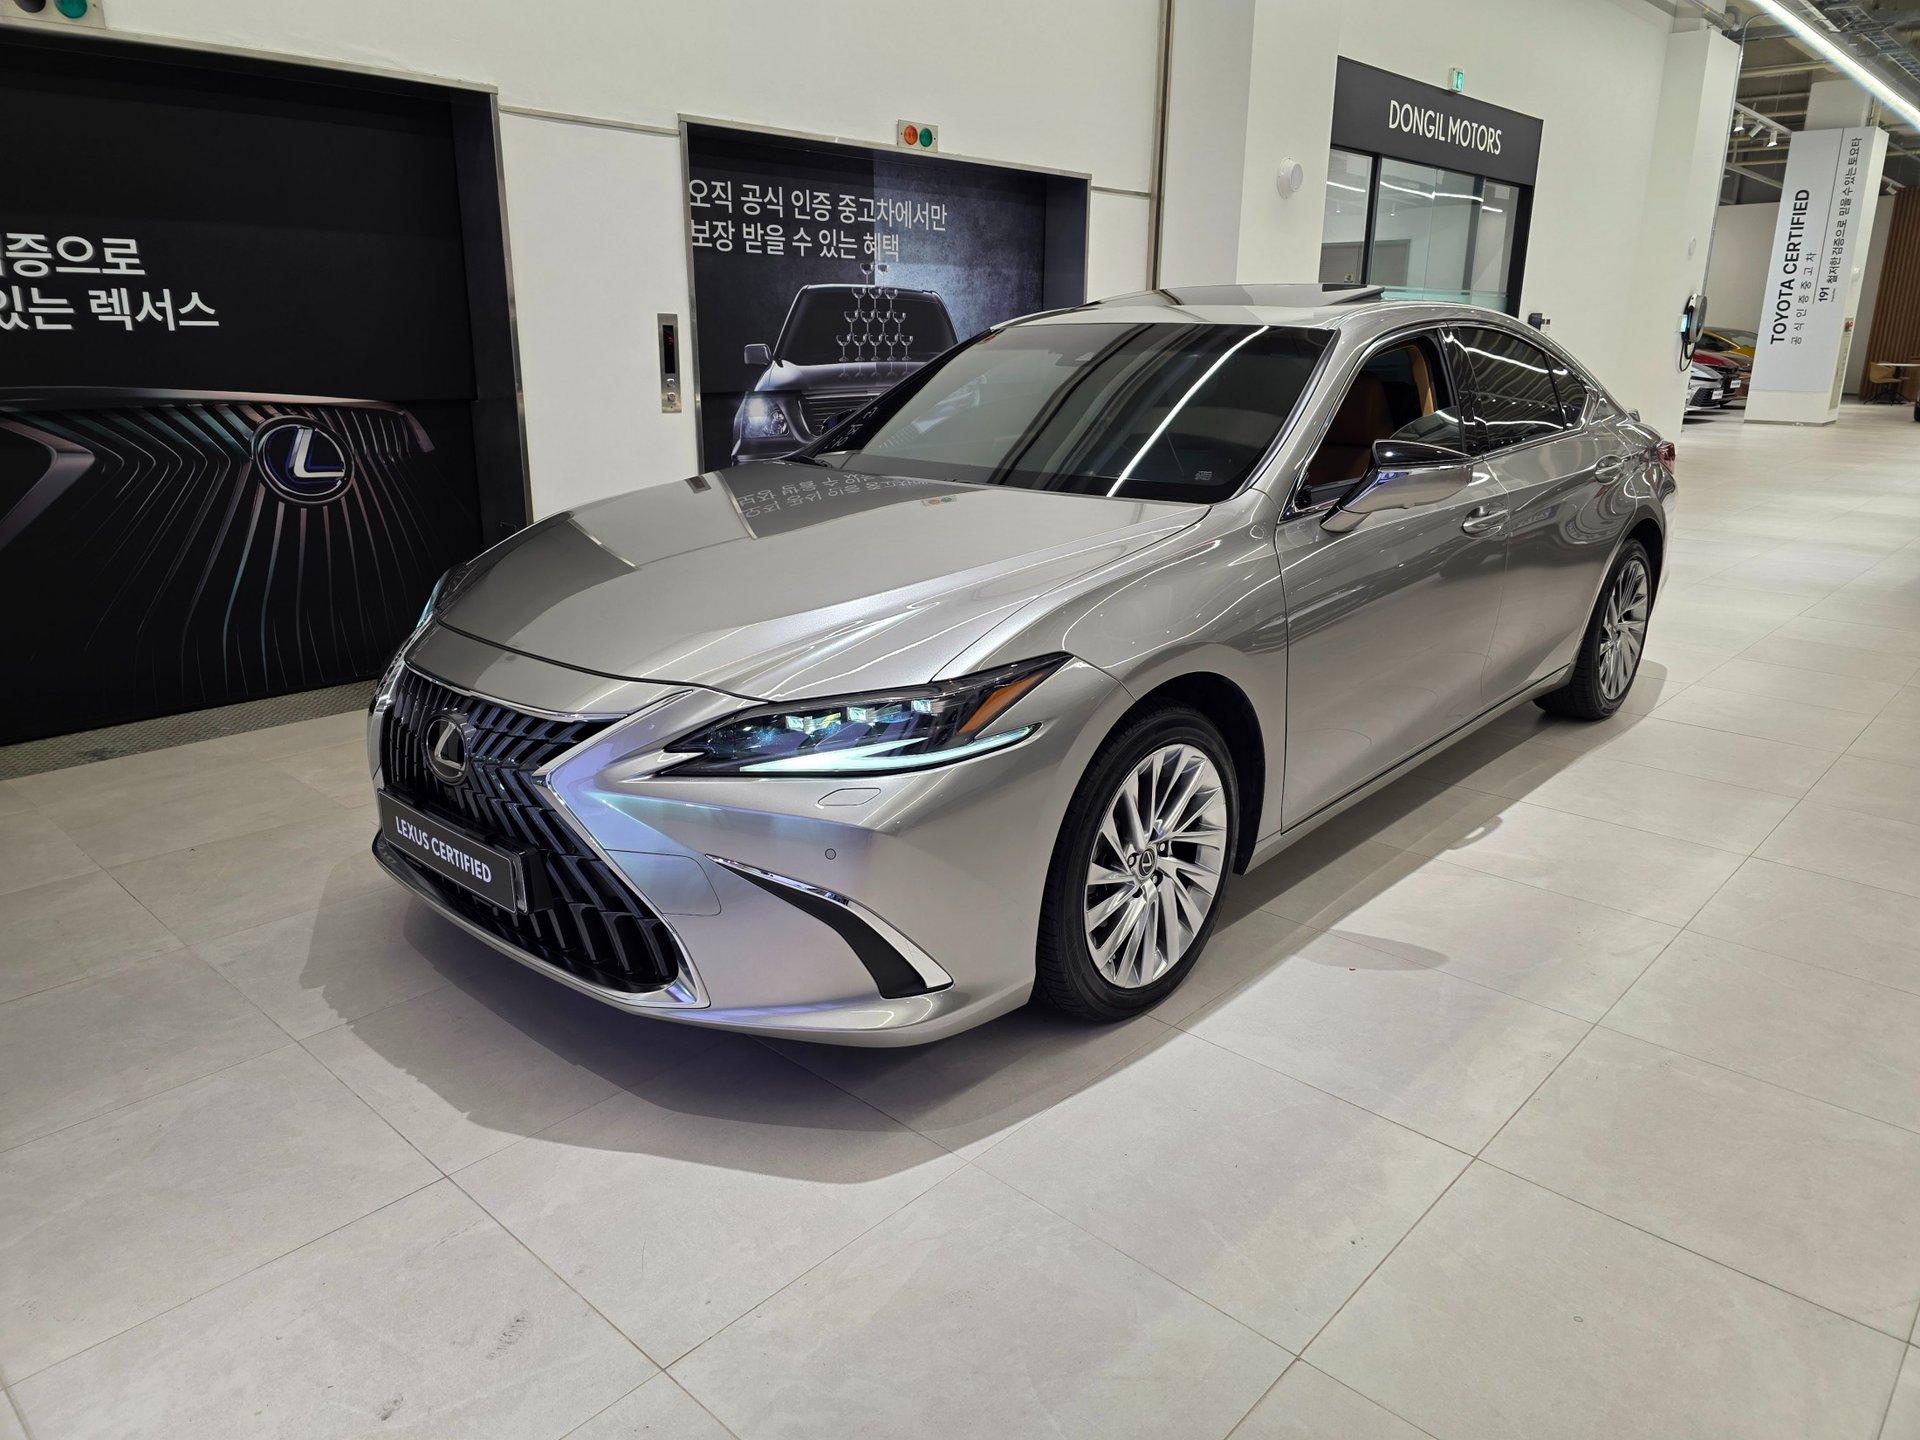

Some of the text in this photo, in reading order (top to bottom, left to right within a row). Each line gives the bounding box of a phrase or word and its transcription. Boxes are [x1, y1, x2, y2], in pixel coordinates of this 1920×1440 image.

[1388, 99, 1502, 155] DONGIL MOTORS
[688, 178, 948, 232] 오직 공식 인증 중고차에서만
[1818, 286, 1830, 302] 191
[1848, 137, 1863, 166] 토요타
[0, 231, 147, 278] 증으로
[690, 219, 900, 262] 보장 받을 수 있는 혜택
[1770, 189, 1810, 345] TOYOTA CERTIFIED
[88, 286, 220, 332] 렉서스
[395, 815, 492, 883] LEXUS CERTIFIED
